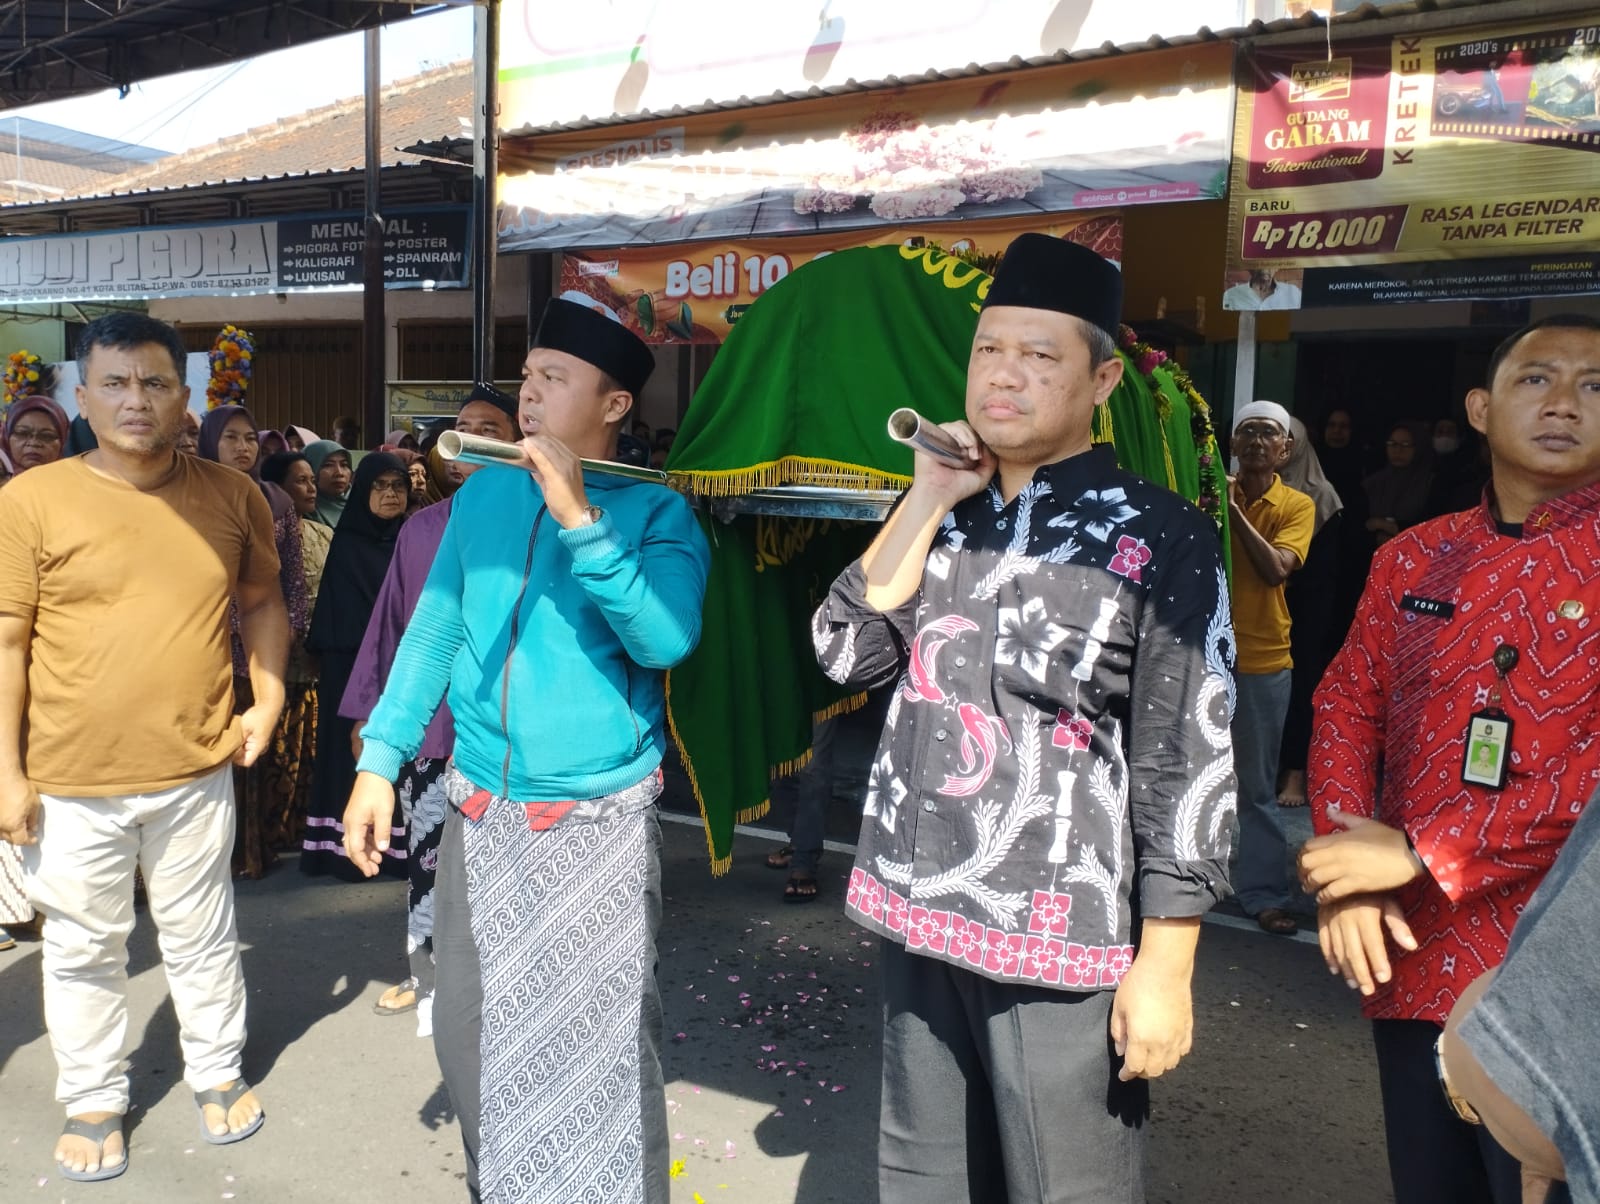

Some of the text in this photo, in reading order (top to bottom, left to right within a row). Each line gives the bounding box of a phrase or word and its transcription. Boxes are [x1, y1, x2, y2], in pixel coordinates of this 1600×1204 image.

[1459, 40, 1498, 57] 2020's
[1392, 37, 1421, 165] KRETEK
[1286, 108, 1349, 126] GUDANG
[1265, 120, 1372, 150] GARAM
[1262, 149, 1369, 173] International
[1250, 200, 1290, 212] BARU
[1420, 206, 1474, 223] RASA
[311, 219, 414, 239] MENAL
[1442, 219, 1584, 241] TANPA FILTER
[295, 241, 366, 255] PIGORA FOT
[397, 237, 447, 249] POSTER
[295, 256, 355, 268] KALIGRAFI
[396, 252, 462, 263] SPANRAM
[396, 267, 419, 278] DLL
[1531, 262, 1592, 271] PERINGATAN
[295, 271, 345, 282] LUKISAN
[665, 251, 789, 298] Beli 10
[1328, 282, 1363, 291] KARENA
[1414, 600, 1439, 611] YONI
